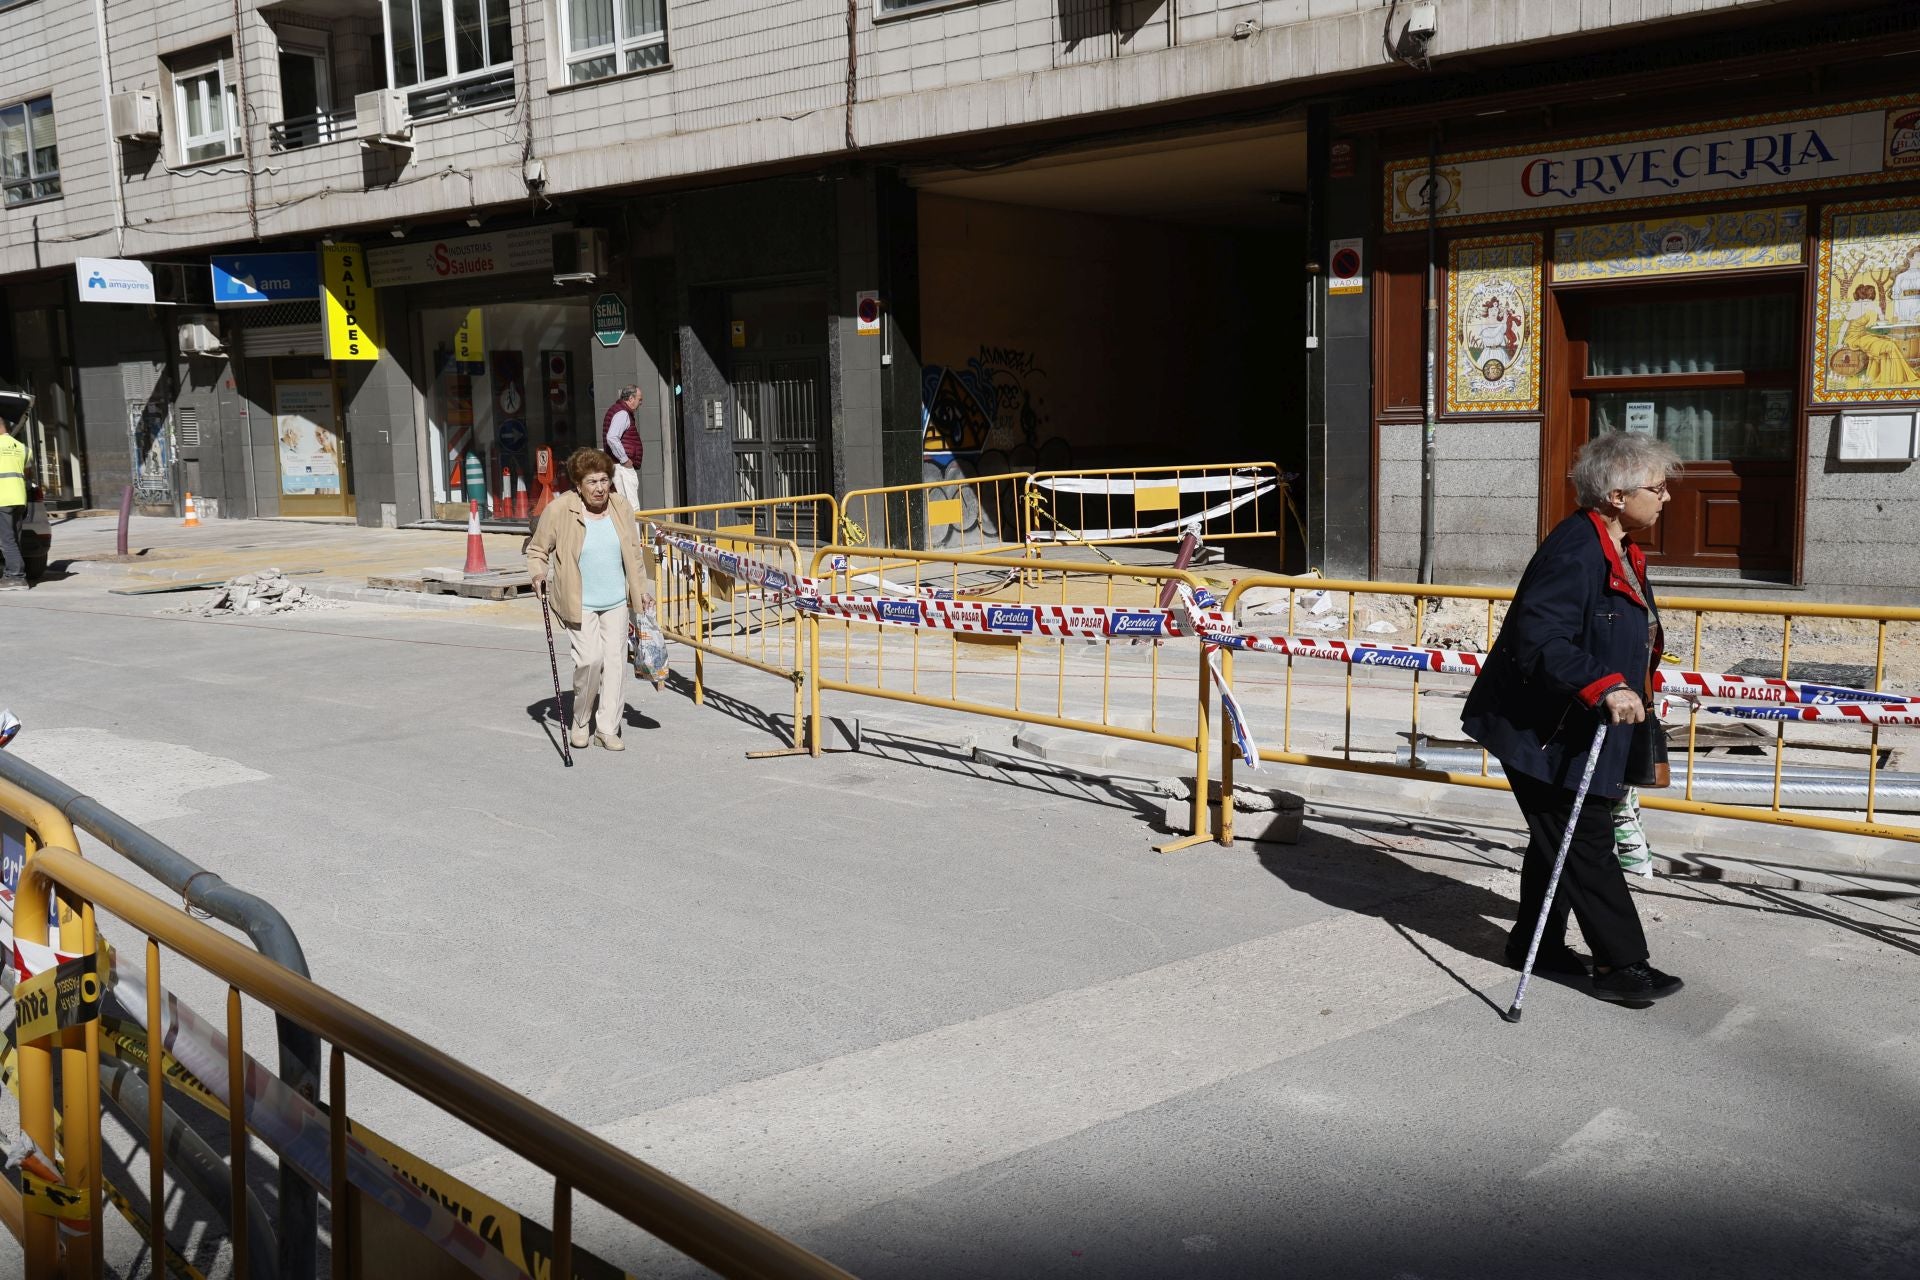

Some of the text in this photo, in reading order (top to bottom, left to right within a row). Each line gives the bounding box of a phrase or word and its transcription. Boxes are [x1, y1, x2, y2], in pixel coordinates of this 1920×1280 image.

[1521, 130, 1839, 199] CERVECERIA
[451, 256, 494, 274] Saludes
[109, 281, 150, 290] amayores
[342, 255, 359, 355] SALUDES
[951, 611, 960, 620] NO
[961, 612, 980, 622] PASAR
[992, 610, 1029, 627] Bertolín
[1069, 617, 1102, 628] NO PASAR
[1115, 615, 1158, 632] Bertolín
[1310, 648, 1340, 660] PASAR
[1671, 685, 1680, 693] 384
[1718, 685, 1782, 701] NO PASAR
